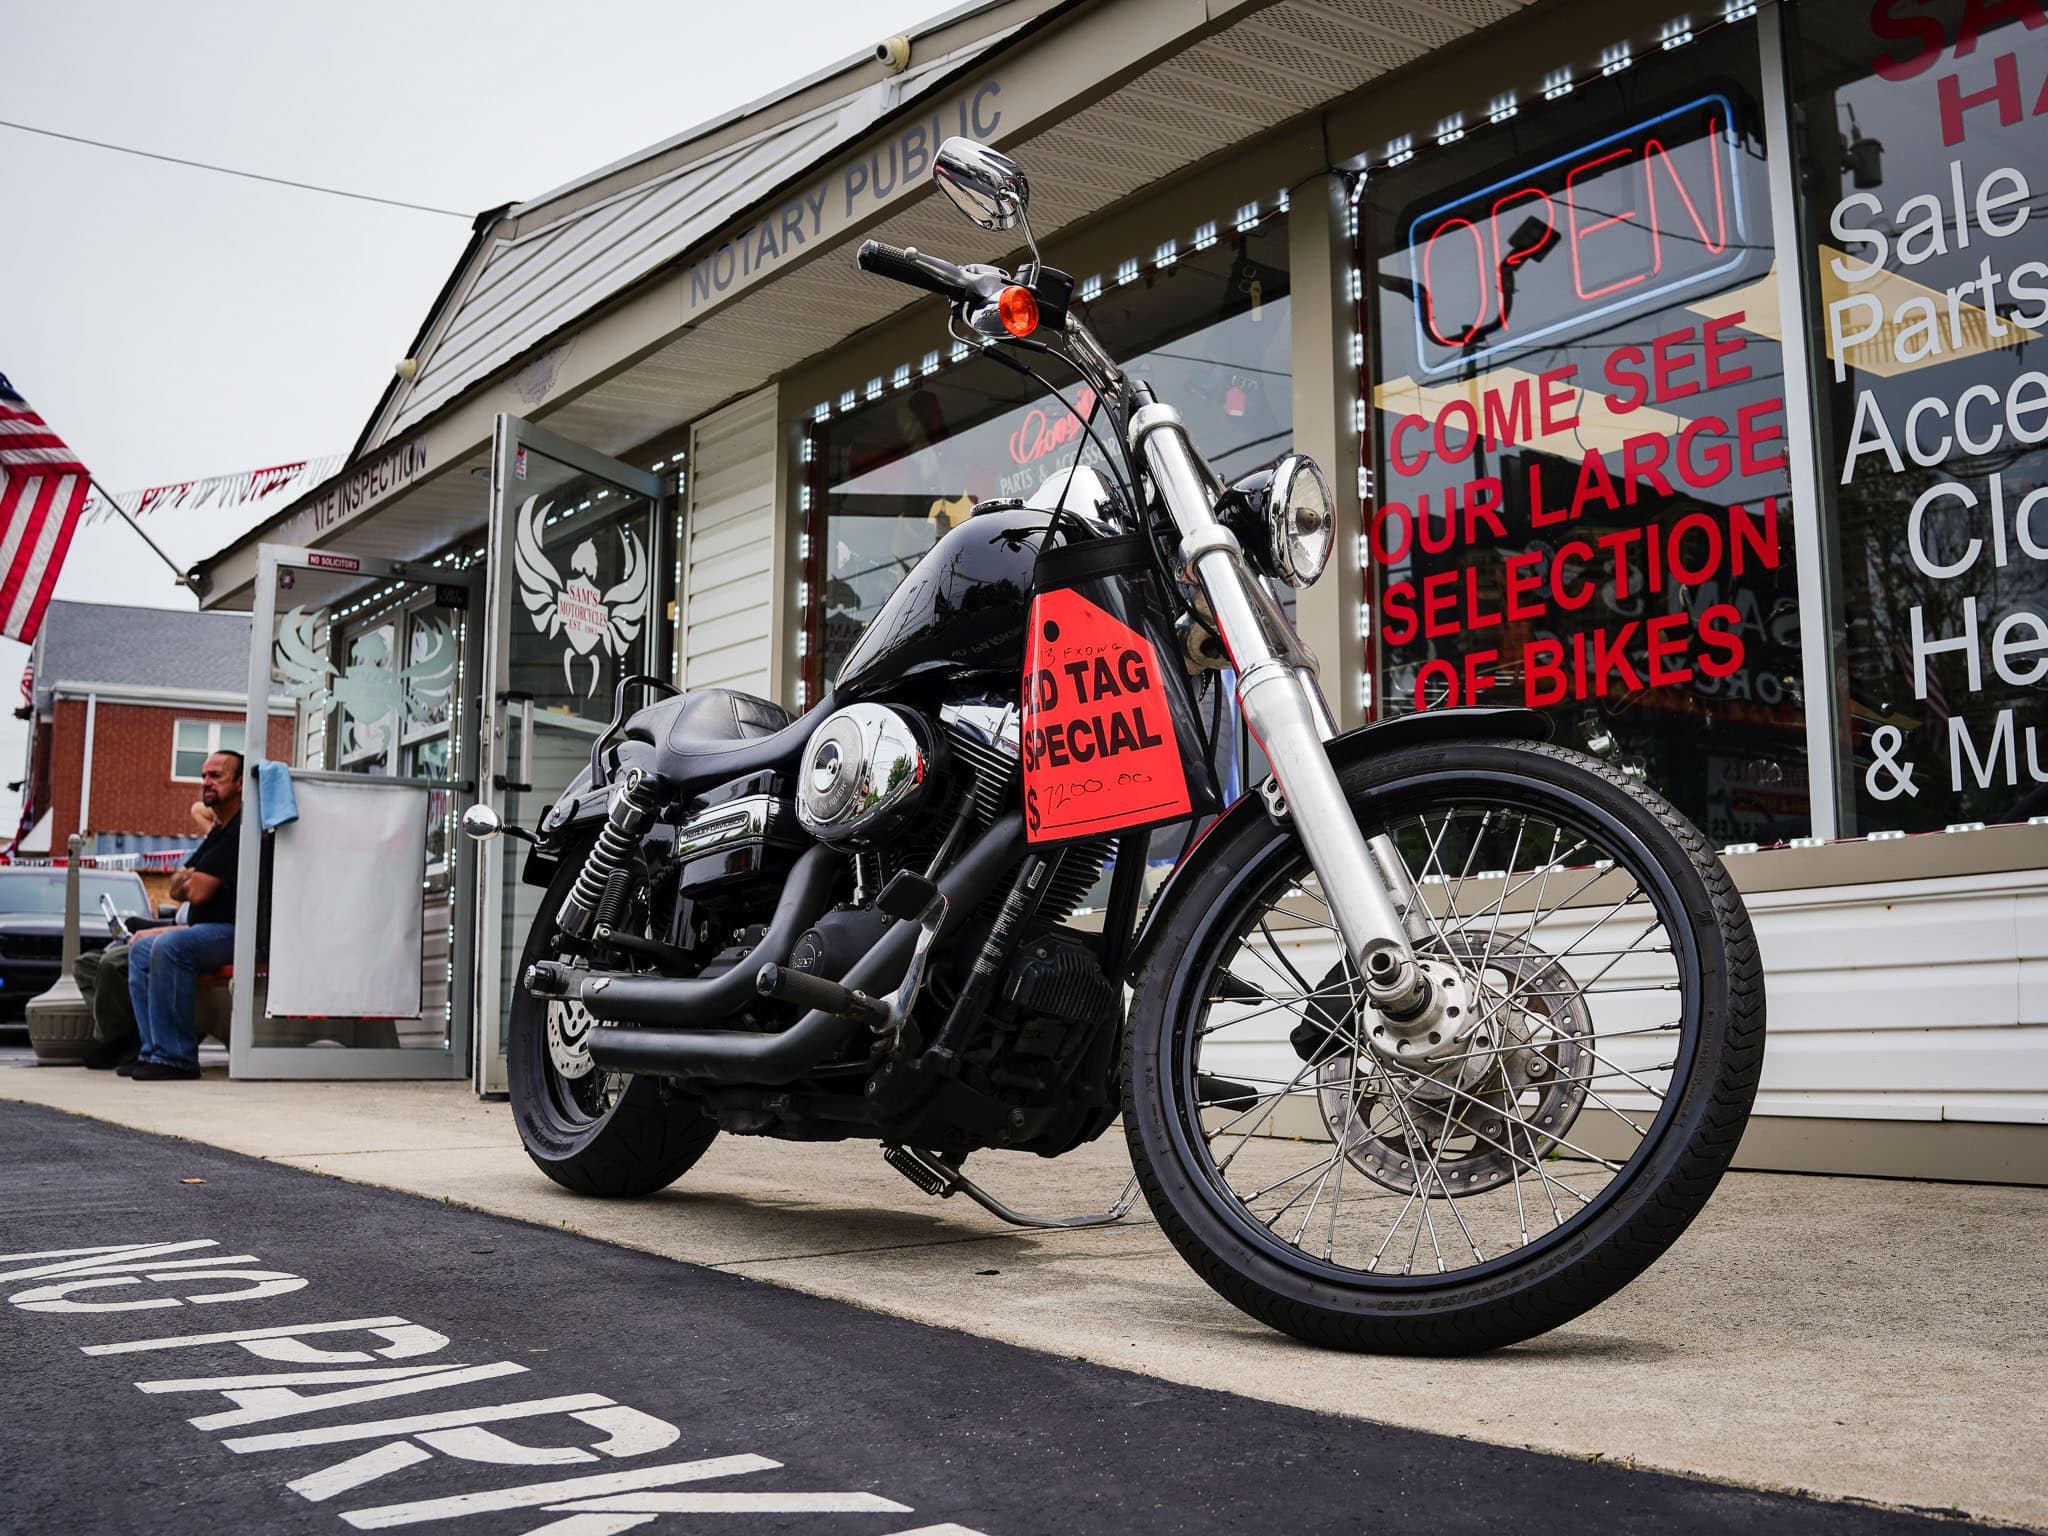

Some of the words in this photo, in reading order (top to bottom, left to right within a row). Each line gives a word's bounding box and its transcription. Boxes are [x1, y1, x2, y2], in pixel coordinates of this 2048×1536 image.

[1937, 52, 2048, 147] H
[690, 184, 828, 308] NOTARY
[844, 81, 1001, 218] PUBLIC
[1424, 118, 1726, 346] OPEN
[1830, 160, 2031, 283] Sale
[1829, 256, 2048, 383] Parts
[1390, 364, 1579, 477] COME
[1604, 310, 1752, 415] SEE
[338, 436, 427, 518] INSPECTION
[1000, 468, 1033, 497] PARTS
[1370, 476, 1508, 566] OUR
[1529, 397, 1788, 529] LARGE
[311, 555, 320, 565] NO
[321, 557, 358, 569] SOLICITORS
[569, 584, 598, 608] SAM'S
[1382, 496, 1780, 646] SELECTION
[559, 601, 609, 627] MOTORCYCLES
[1414, 648, 1498, 711] OF
[1523, 604, 1745, 708] BIKES
[1023, 668, 1059, 716] RED
[1065, 649, 1149, 704] TAG
[1024, 707, 1163, 773] SPECIAL
[1865, 725, 1920, 801] &
[1027, 785, 1041, 837] $
[0, 1239, 308, 1312] NO
[79, 1316, 993, 1536] PARK
